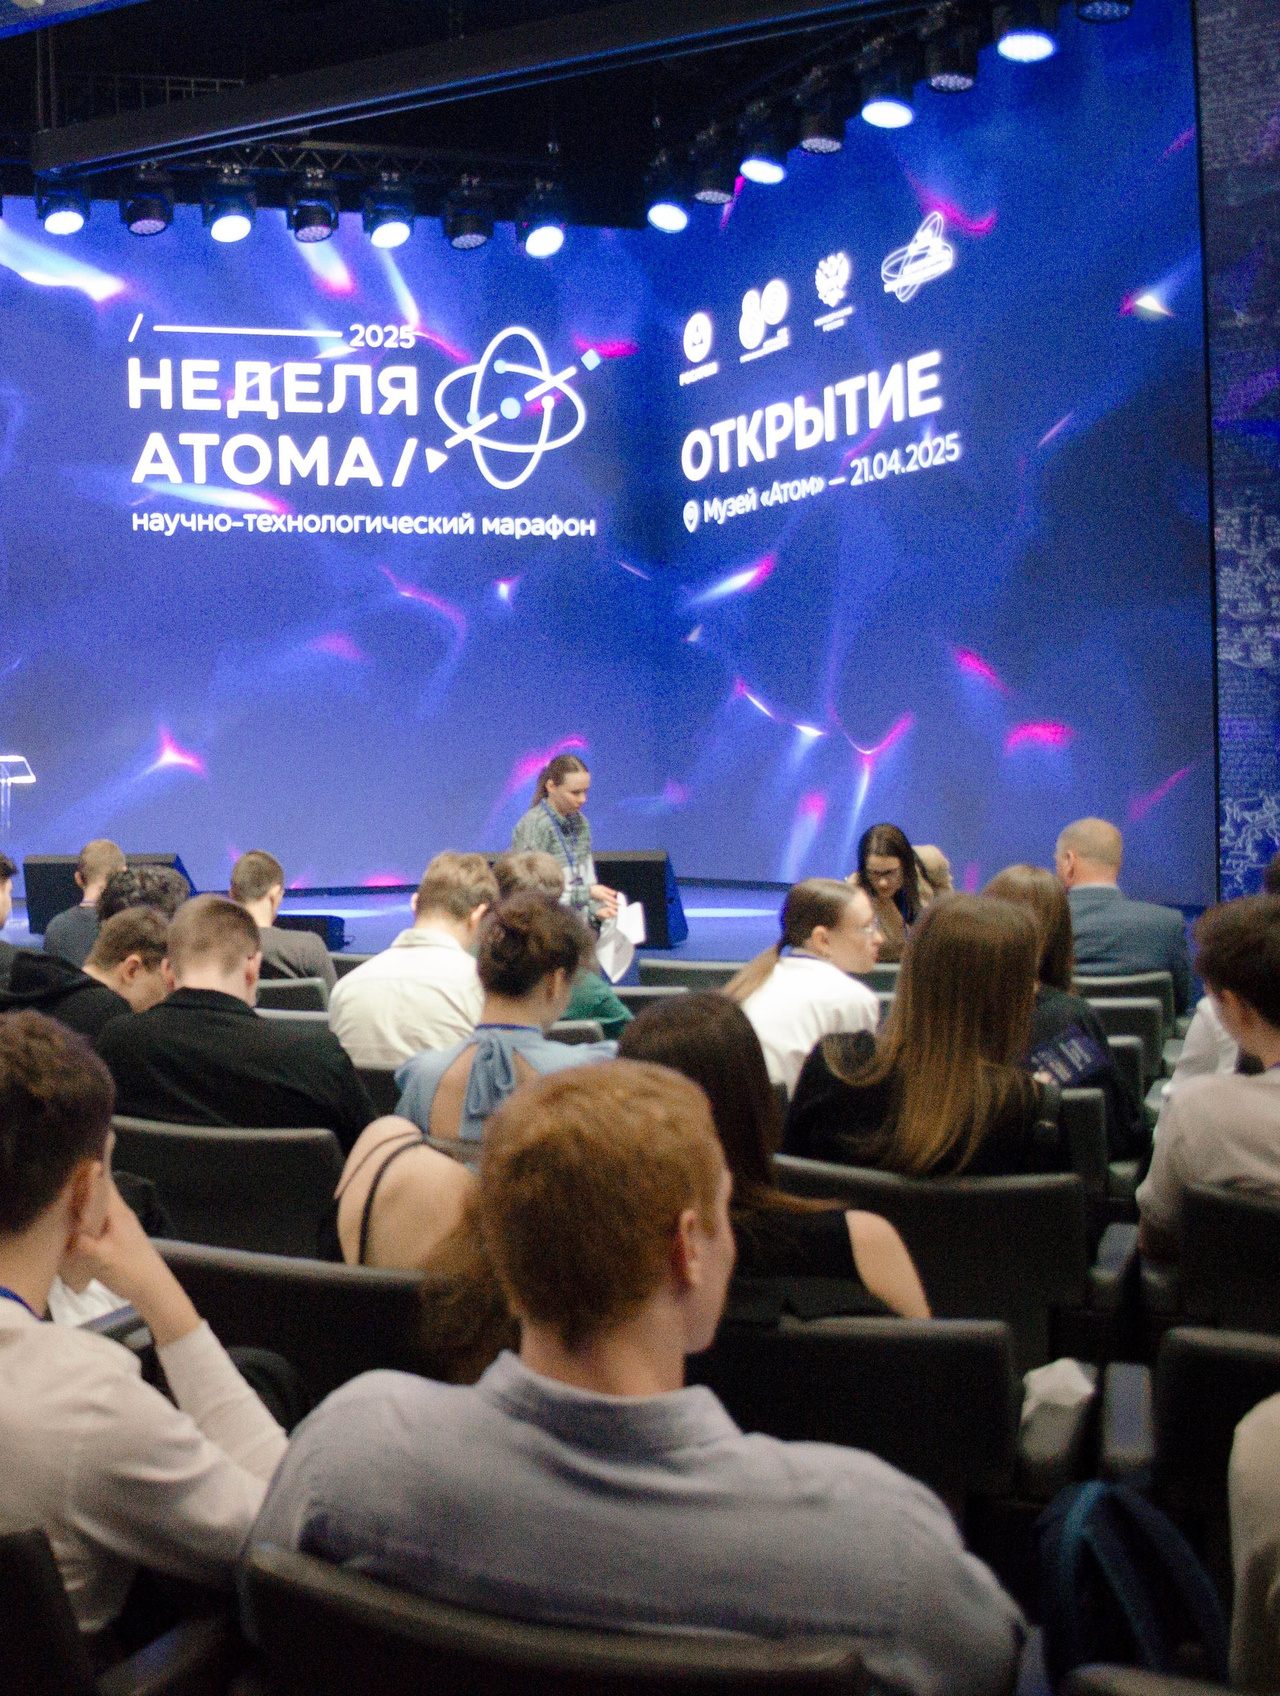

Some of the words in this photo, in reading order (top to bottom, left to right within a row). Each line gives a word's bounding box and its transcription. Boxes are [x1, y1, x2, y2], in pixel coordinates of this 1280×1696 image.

[349, 324, 416, 349] 2025
[128, 358, 418, 419] НЕДЕЛЯ
[681, 350, 943, 482] ОТКРЫТИЕ
[704, 488, 757, 524] Музей
[850, 432, 961, 486] 21.04.2025
[132, 511, 474, 536] научно-технологический
[482, 514, 596, 540] марафон
